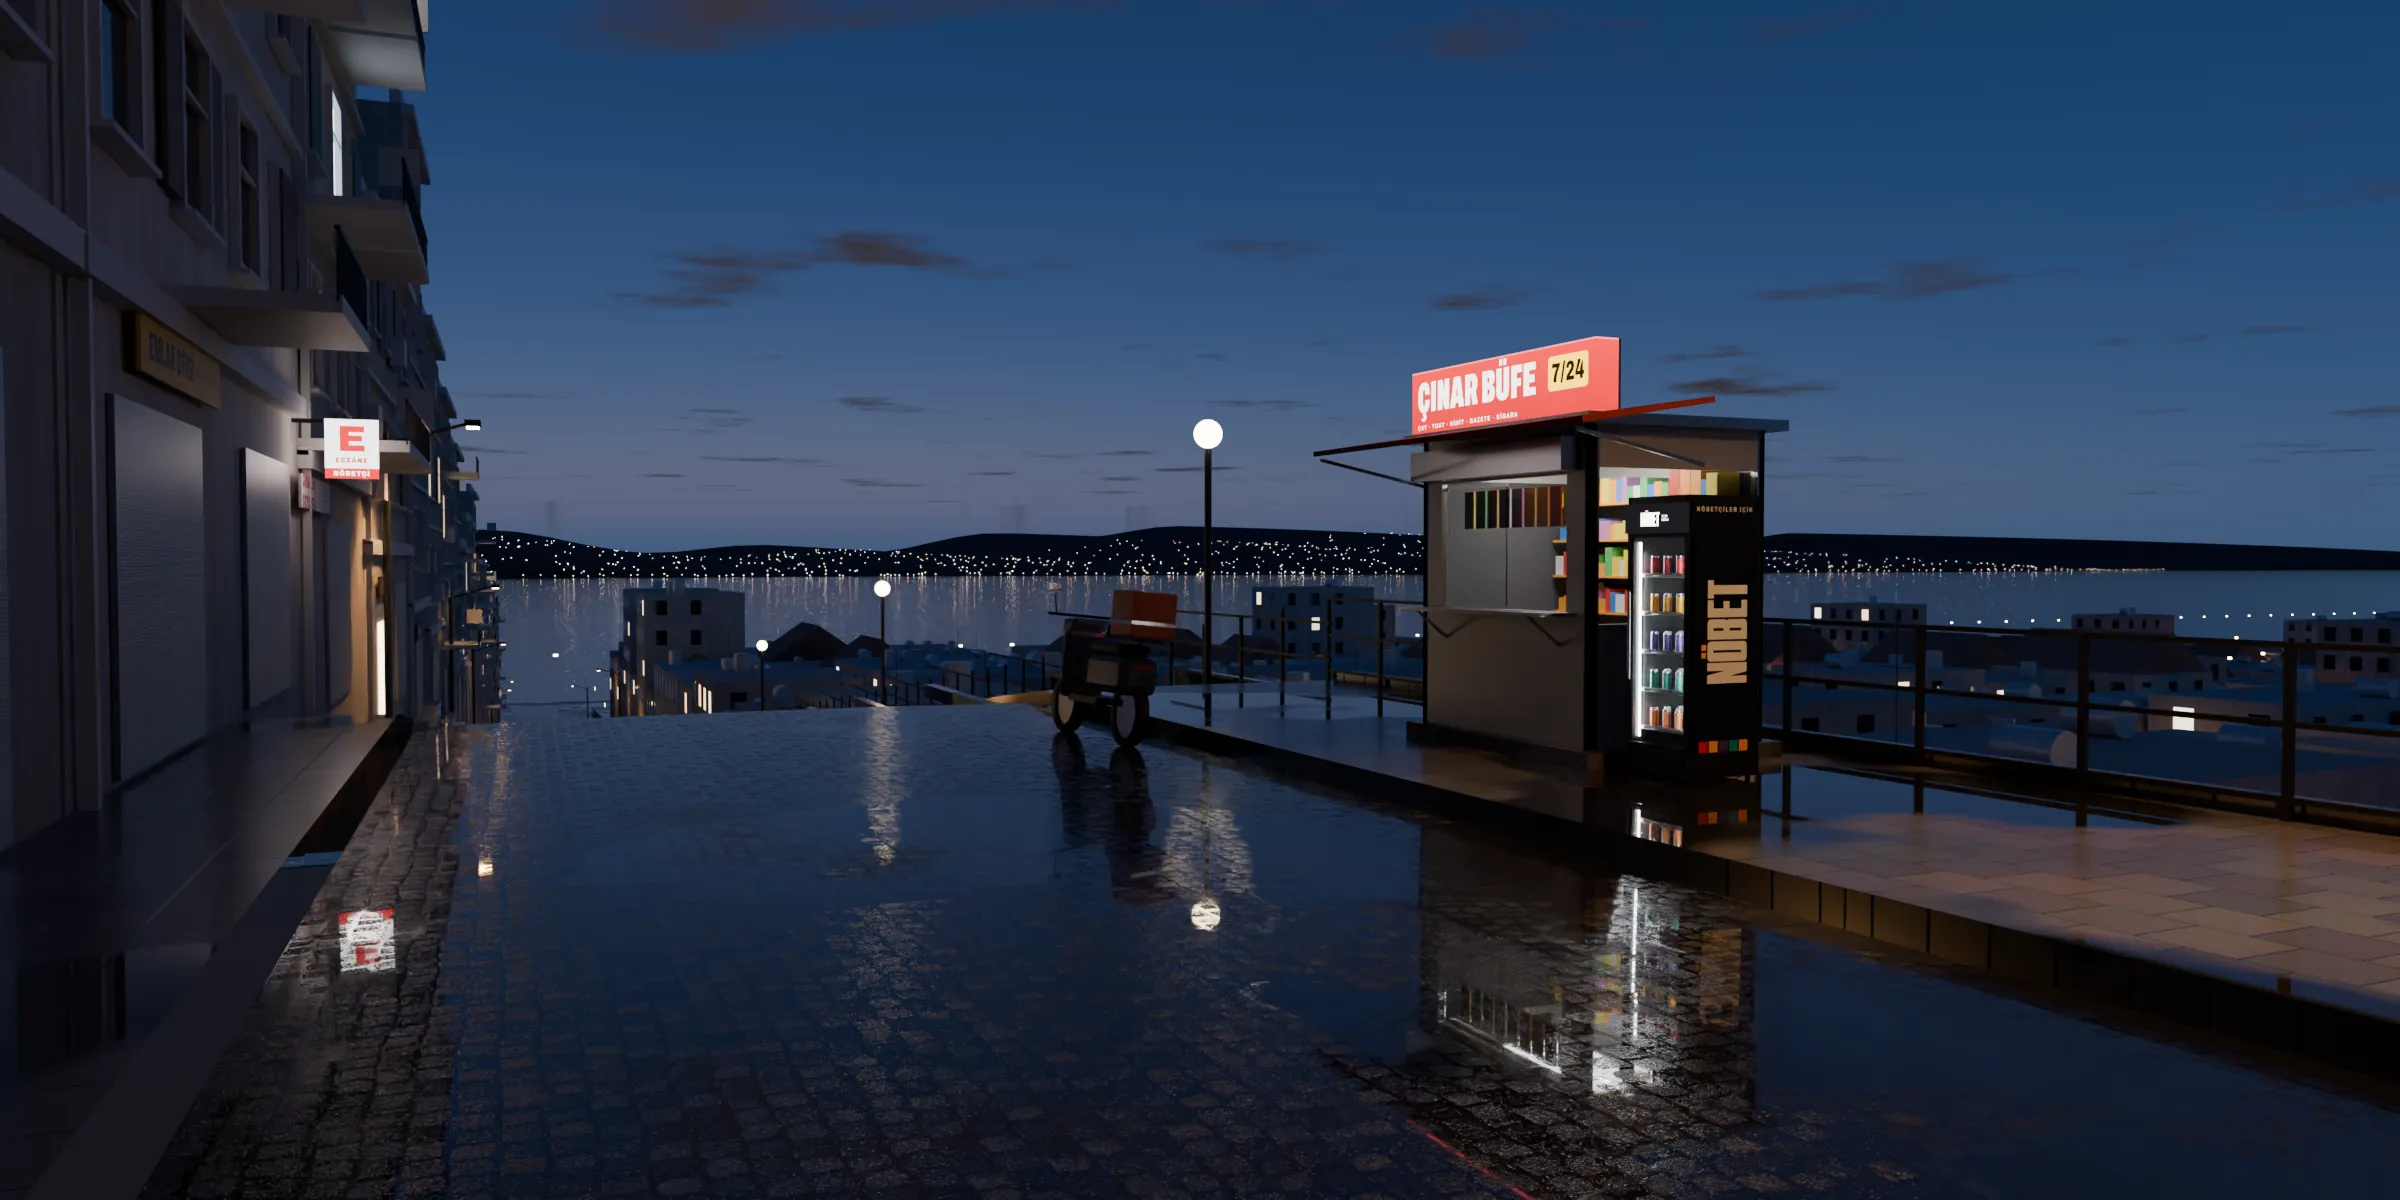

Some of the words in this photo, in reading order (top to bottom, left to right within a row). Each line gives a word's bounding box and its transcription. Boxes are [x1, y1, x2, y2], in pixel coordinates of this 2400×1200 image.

[1552, 358, 1584, 383] 7/24
[1417, 374, 1479, 422] ÇINAR
[1481, 357, 1537, 404] BÜFE
[1432, 421, 1445, 429] TOST
[1469, 415, 1491, 424] GAZETE
[340, 425, 365, 451] E
[332, 468, 371, 479] NÖBETÇİ
[1700, 579, 1748, 685] NÖBET
